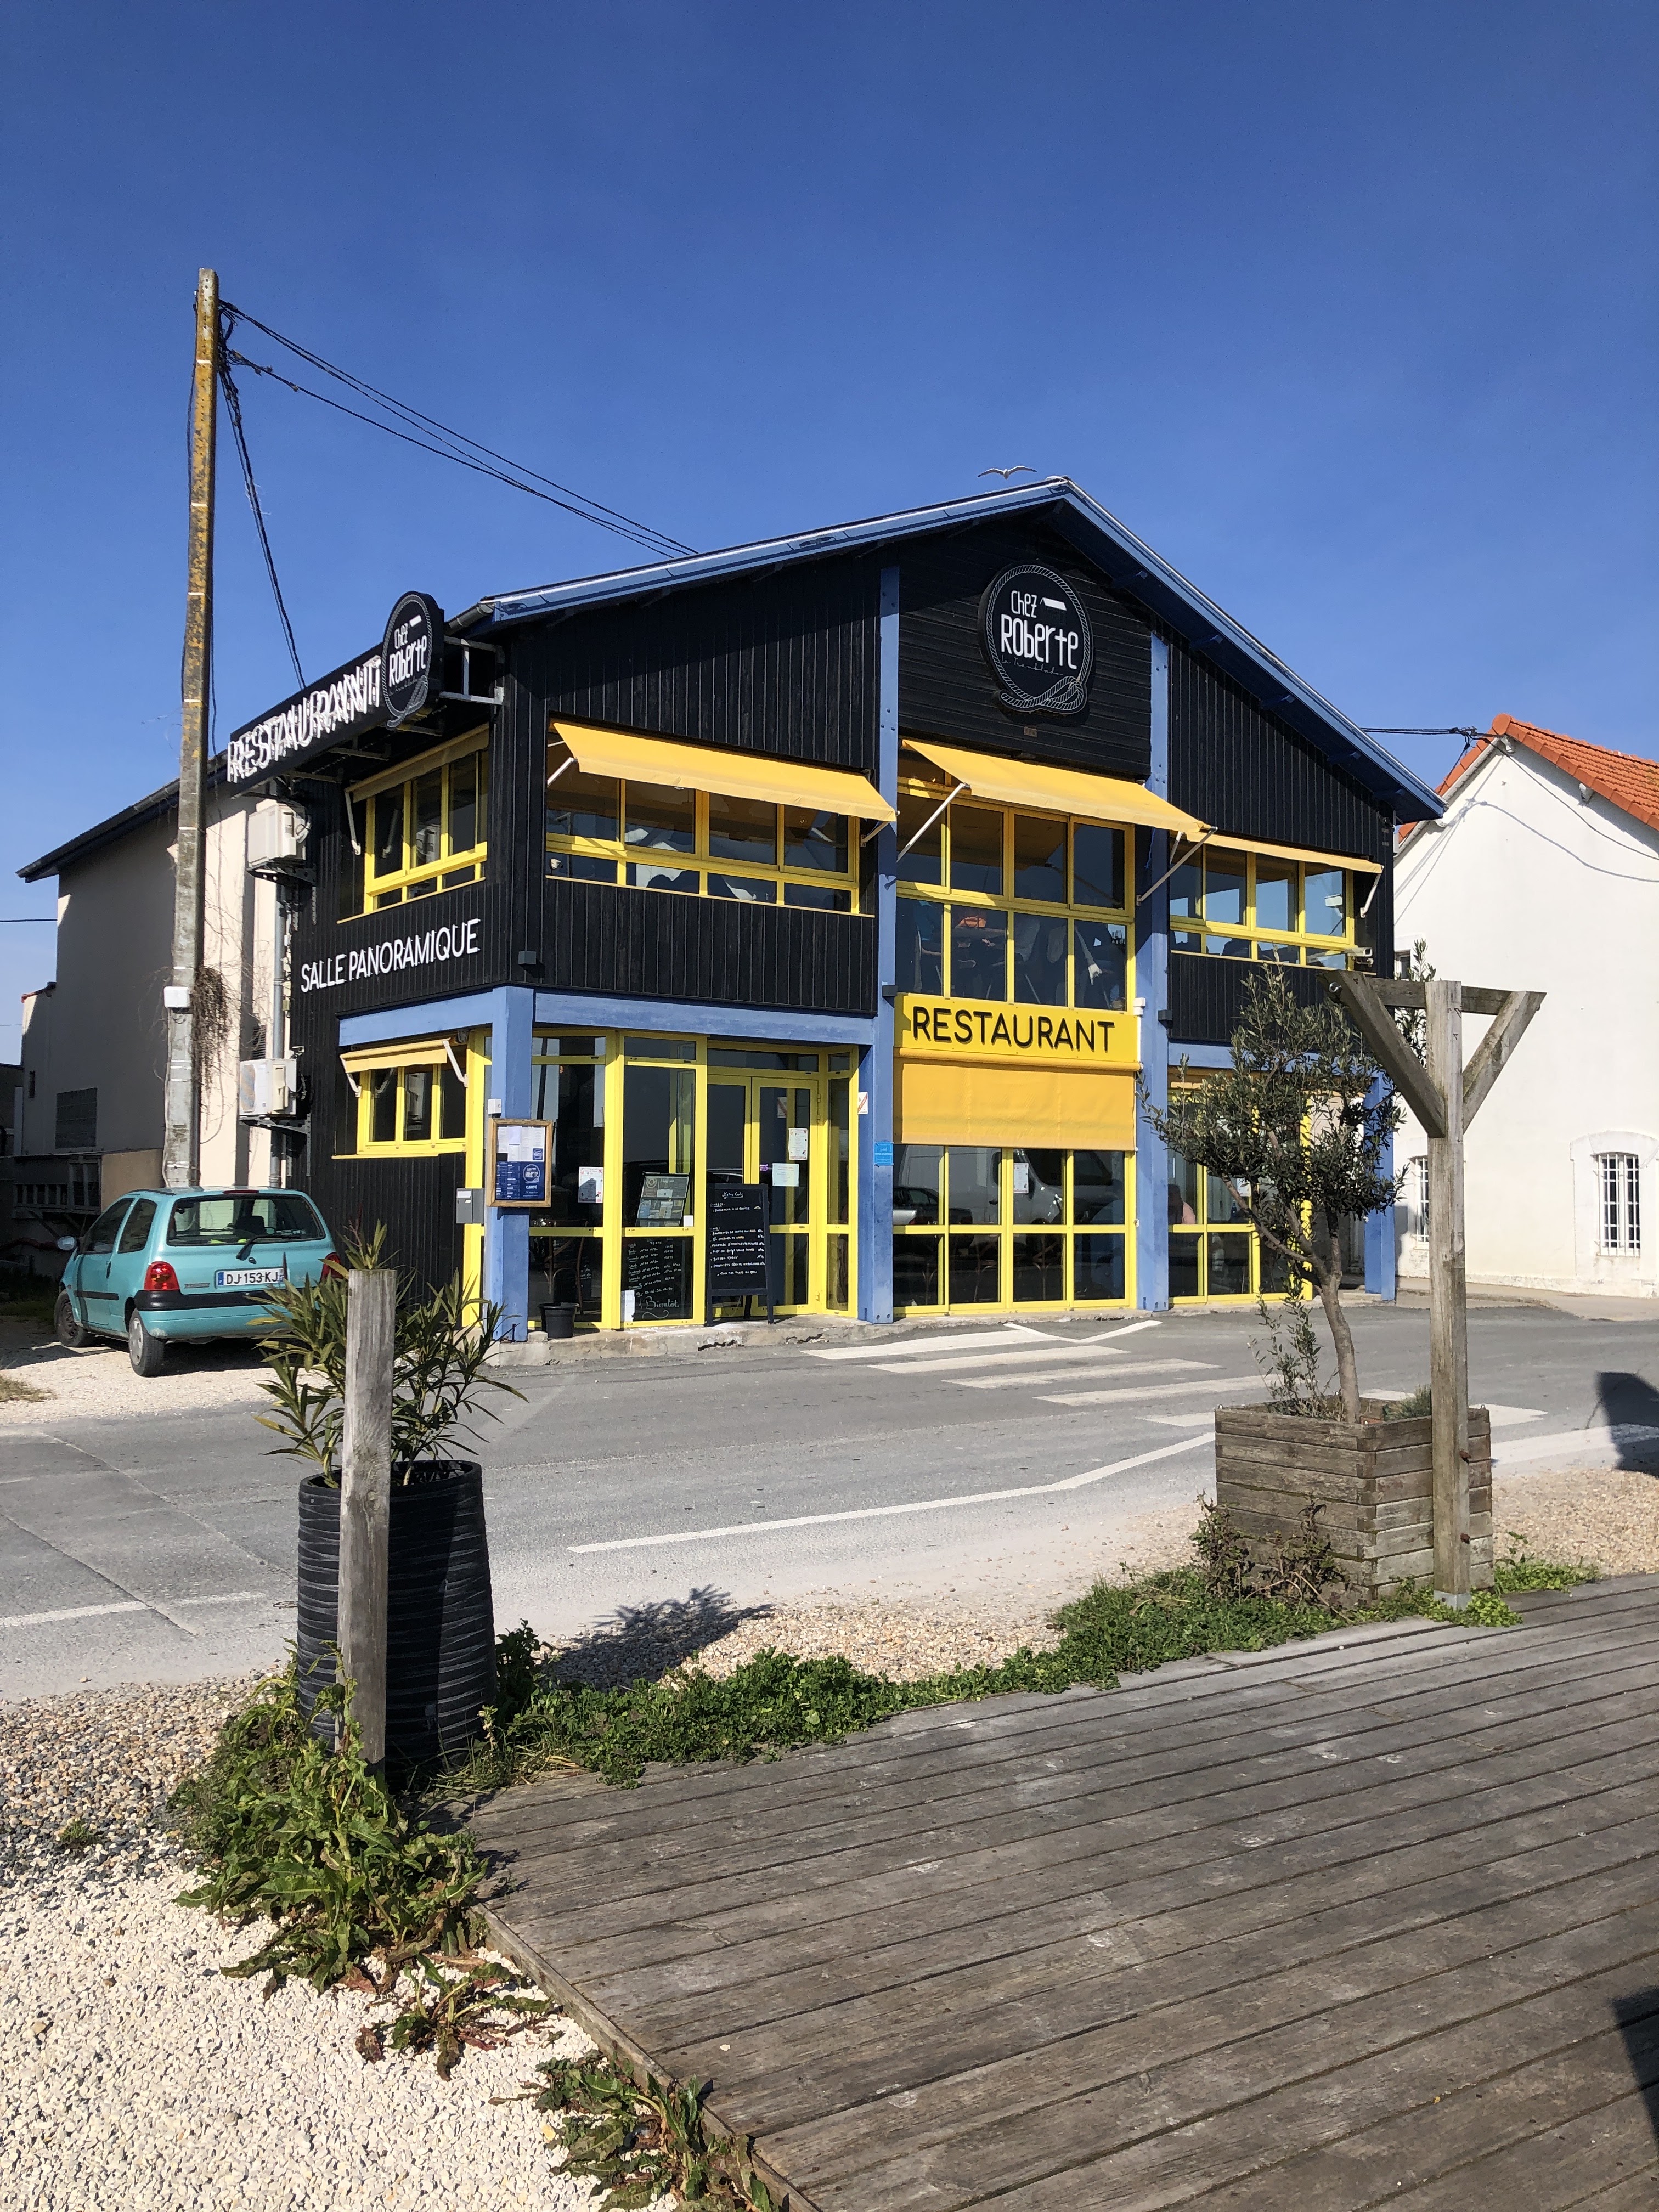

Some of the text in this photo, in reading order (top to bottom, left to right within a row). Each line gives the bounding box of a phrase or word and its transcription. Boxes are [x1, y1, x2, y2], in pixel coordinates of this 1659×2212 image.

[1011, 590, 1037, 618] Chez
[394, 622, 408, 649] Chez
[227, 654, 381, 783] RESTAURANT
[301, 918, 481, 993] SALLE PANORAMIQUE
[913, 1006, 1115, 1053] RESTAURANT
[227, 1271, 278, 1285] DJ-153-KJ
